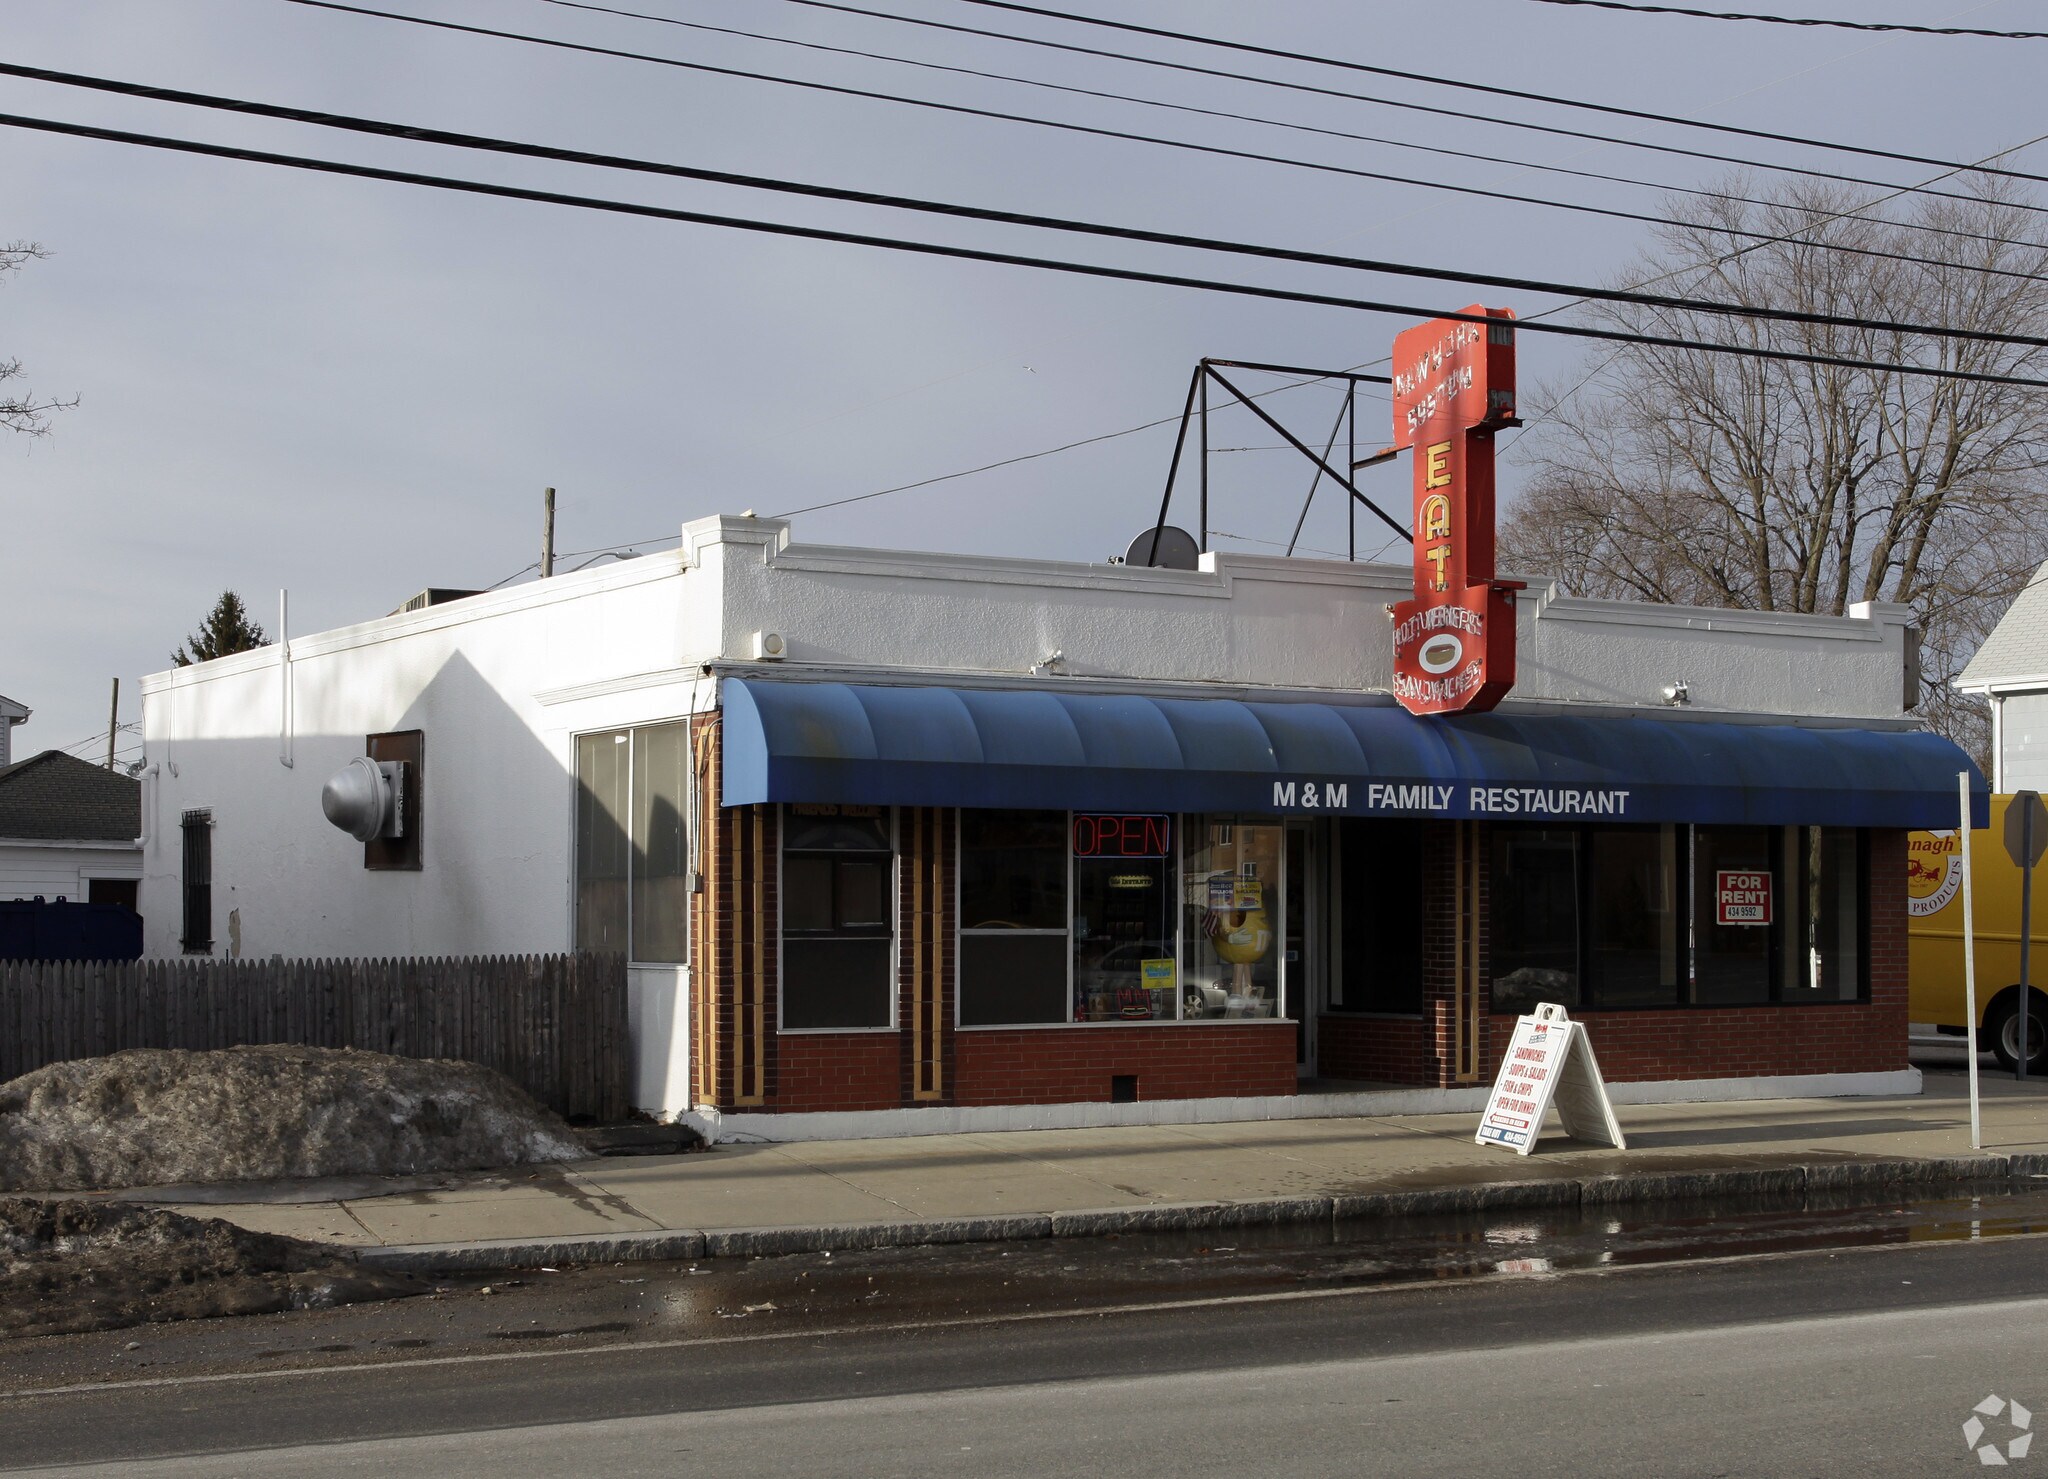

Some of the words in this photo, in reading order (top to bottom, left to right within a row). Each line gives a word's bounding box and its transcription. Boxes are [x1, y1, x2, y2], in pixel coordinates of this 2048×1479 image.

[1423, 440, 1453, 594] EAT
[1367, 784, 1455, 810] FAMILY
[1469, 786, 1630, 814] RESTAURANT
[1073, 817, 1168, 856] OPEN
[1727, 876, 1761, 889] FOR
[1913, 861, 1961, 912] PRODUCTS
[1721, 891, 1767, 904] RENT
[1528, 1067, 1547, 1080] SALADS
[1497, 1097, 1510, 1110] OPEN
[1508, 1099, 1519, 1111] FOR
[1518, 1101, 1536, 1115] DINNER
